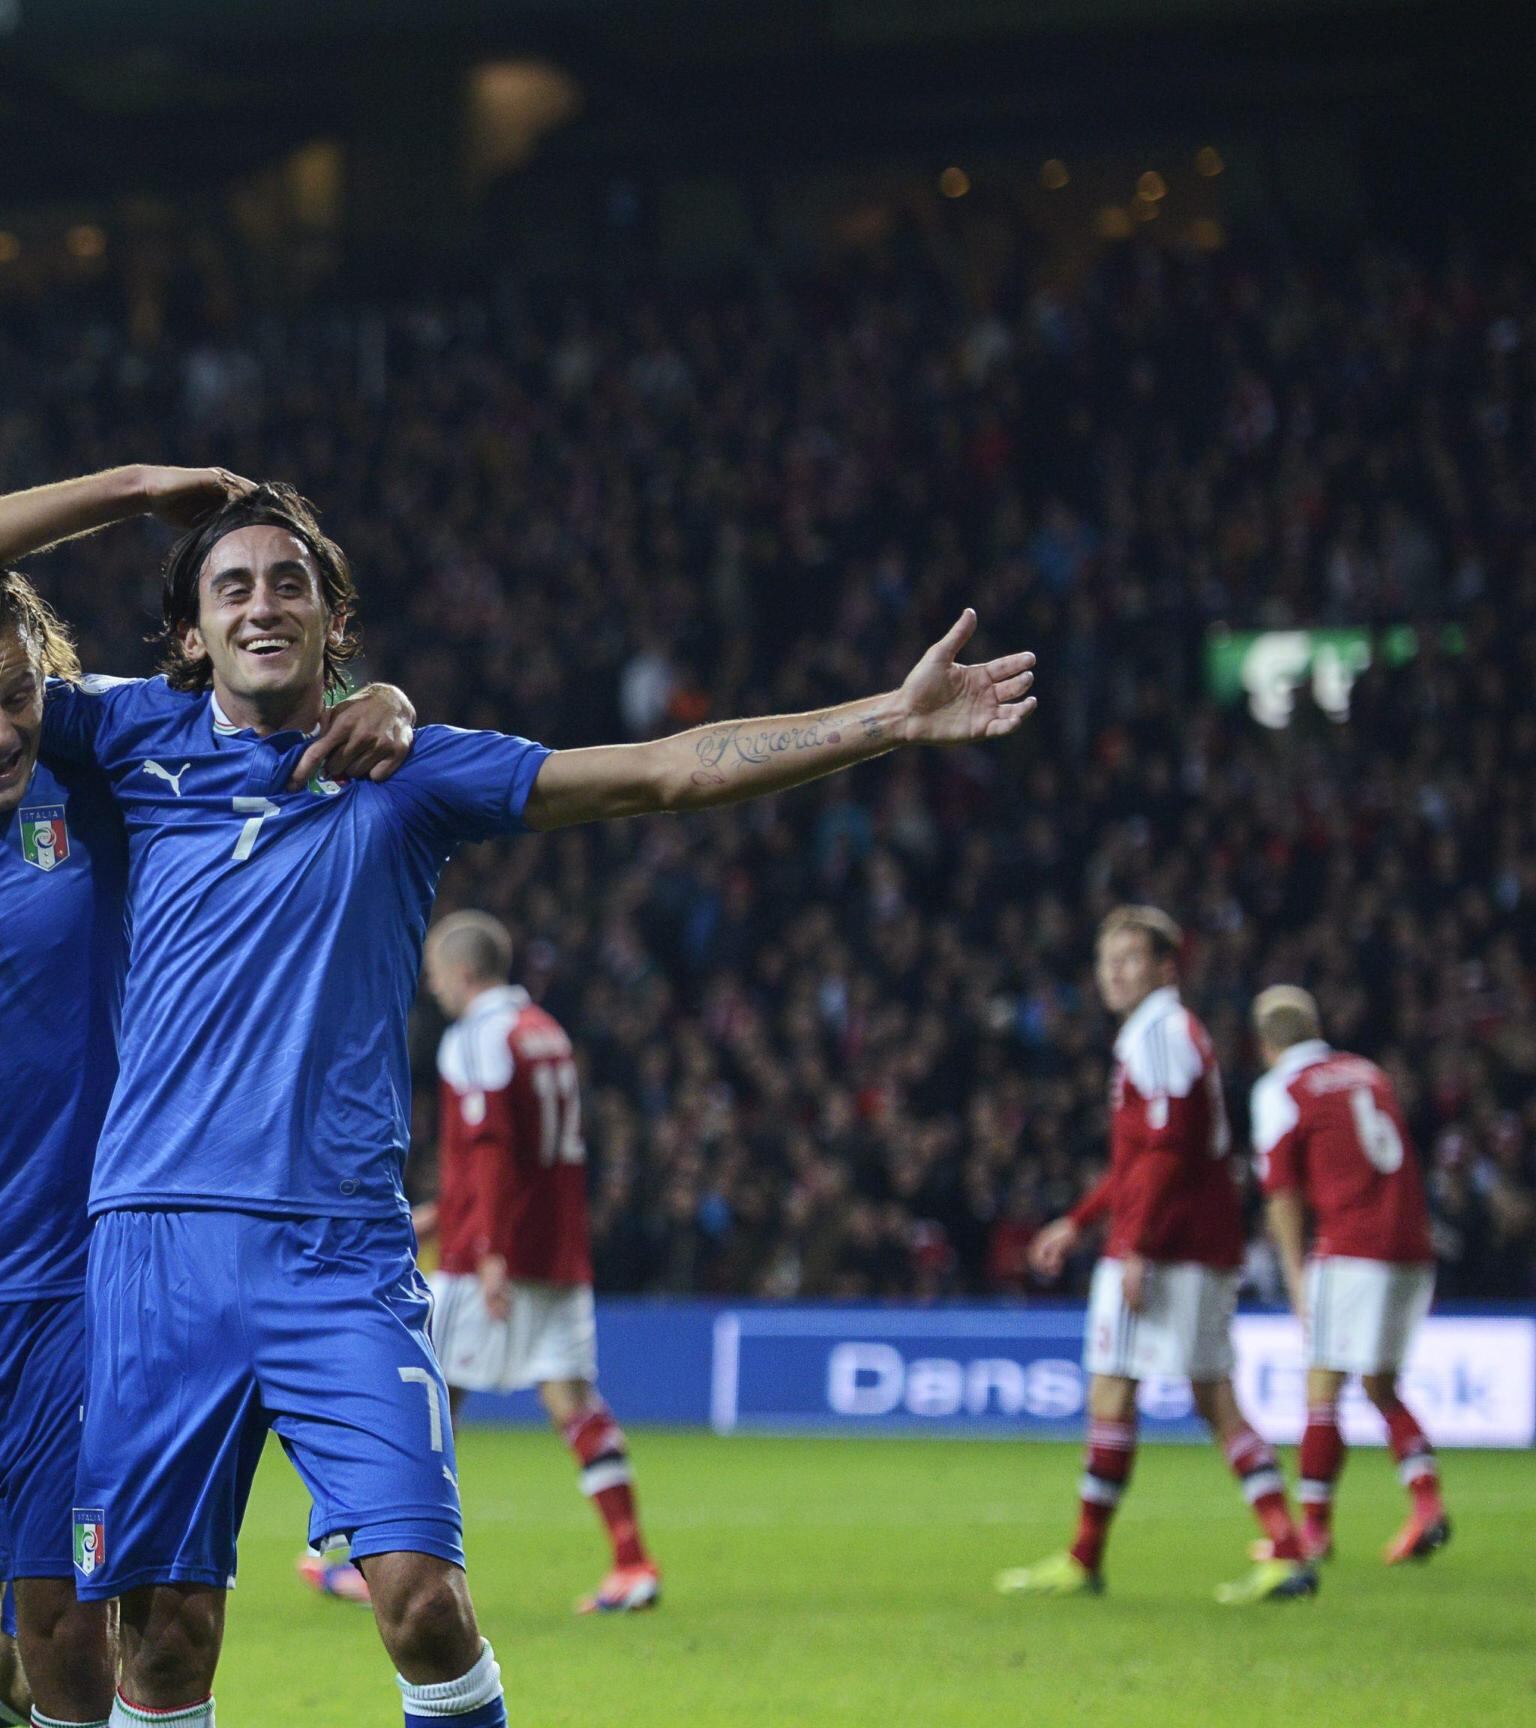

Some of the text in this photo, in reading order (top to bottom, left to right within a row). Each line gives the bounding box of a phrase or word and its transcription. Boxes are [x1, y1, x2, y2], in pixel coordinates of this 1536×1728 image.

[25, 810, 58, 820] ITALIA
[232, 797, 280, 860] 7
[533, 1063, 586, 1168] 12
[1351, 1087, 1404, 1174] 6
[398, 1366, 443, 1452] 7
[828, 1341, 1193, 1418] Danse
